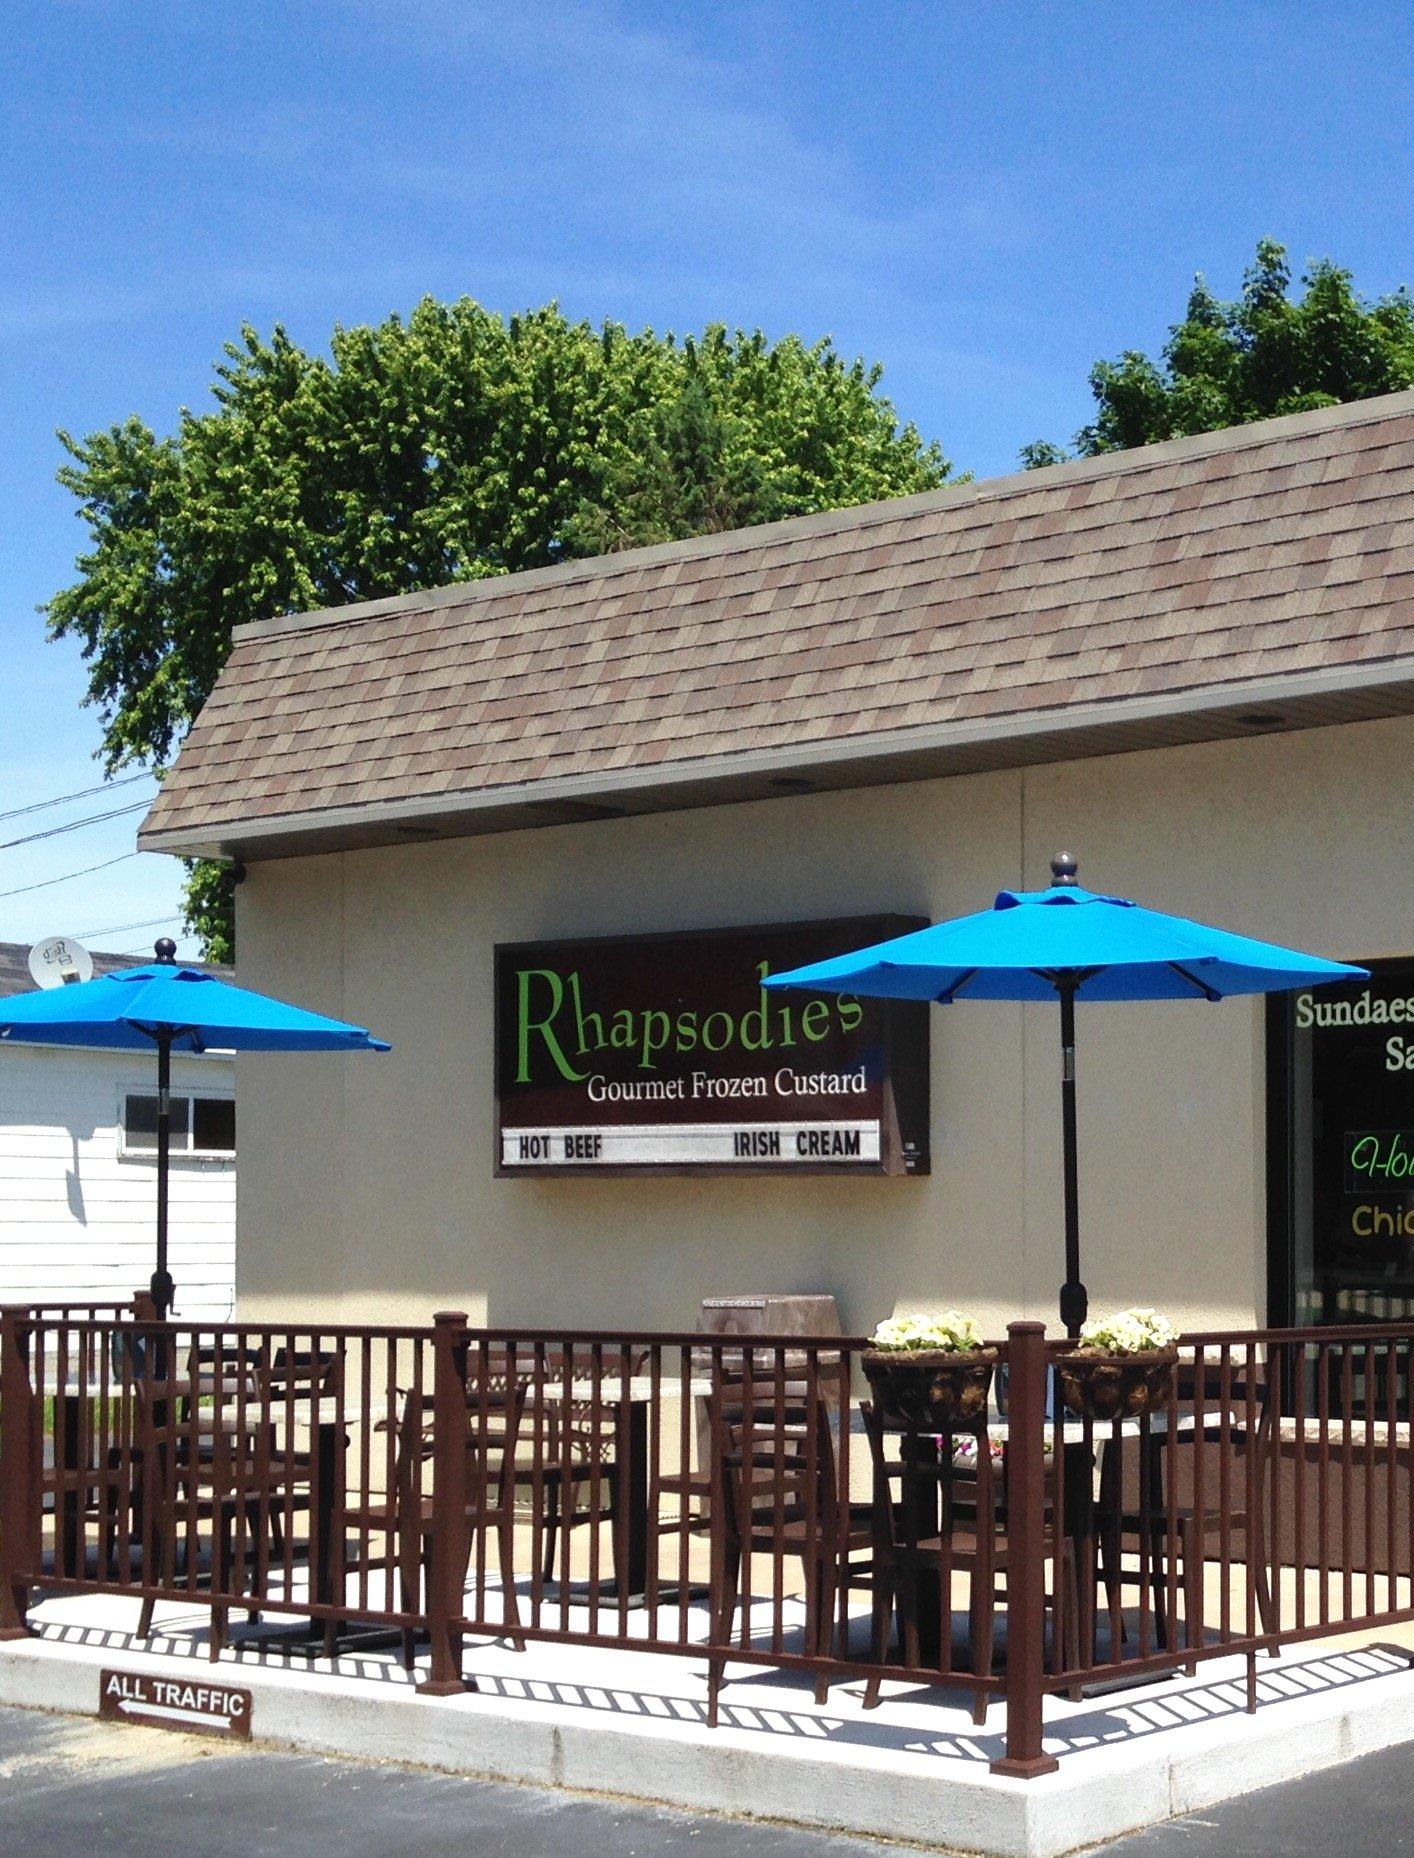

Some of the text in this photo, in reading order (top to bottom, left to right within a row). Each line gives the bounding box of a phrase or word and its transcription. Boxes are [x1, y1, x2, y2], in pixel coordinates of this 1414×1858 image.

[516, 961, 864, 1083] Rhapsodies
[587, 1065, 867, 1102] Gourmet Frozen Custard
[519, 1134, 602, 1159] HOT BEEF
[734, 1130, 861, 1156] IRISH CREAM
[106, 1674, 244, 1716] ALL TRAFFIC
